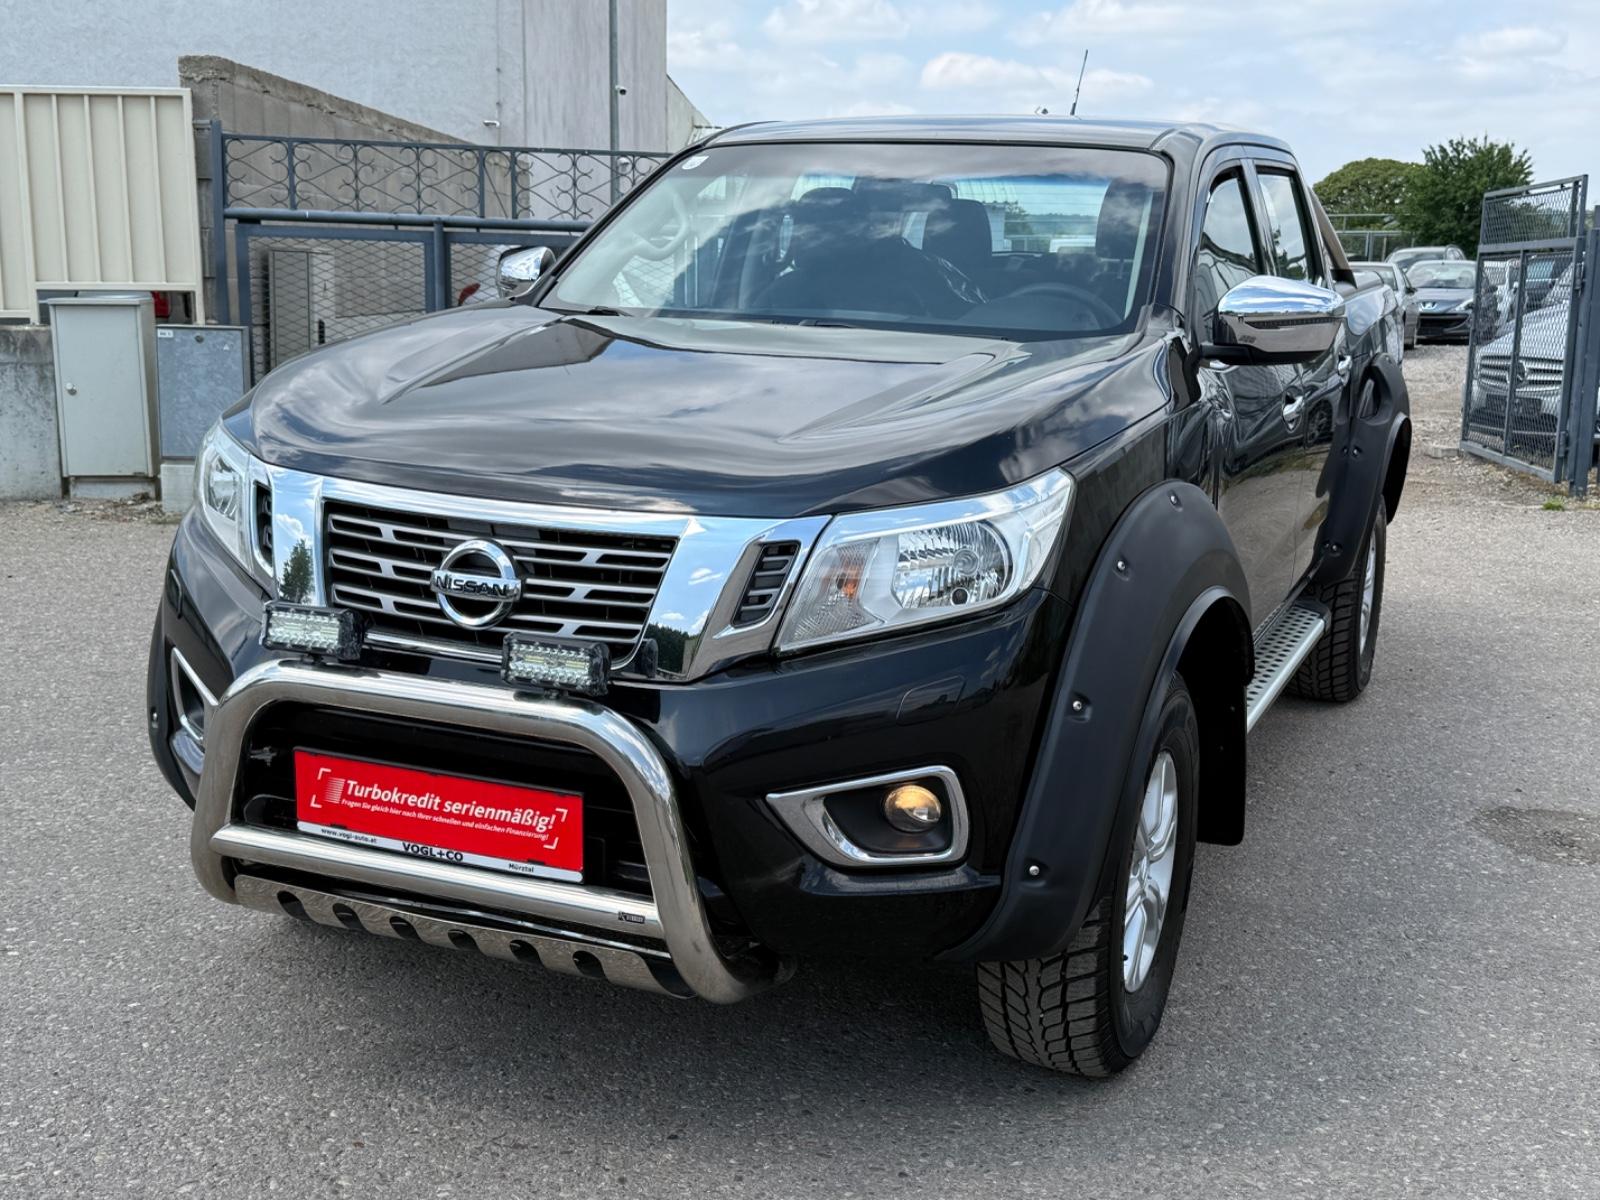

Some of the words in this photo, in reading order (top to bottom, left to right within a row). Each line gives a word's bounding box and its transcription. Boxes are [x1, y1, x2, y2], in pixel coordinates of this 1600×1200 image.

[436, 574, 507, 597] NISSAN
[341, 799, 361, 809] Fragen
[362, 802, 371, 810] Sie
[371, 804, 389, 813] gleich
[389, 807, 401, 815] hier
[402, 809, 417, 818] nach
[417, 812, 432, 821] Ihrer
[432, 814, 461, 826] schnellen
[462, 820, 474, 828] und
[474, 822, 505, 833] einfachen
[506, 827, 550, 841] Finanzierung!
[346, 780, 441, 811] Turbokredit
[442, 800, 556, 833] serienmäßig!
[321, 828, 377, 844] www.vogl-auto.at
[402, 842, 463, 862] VOGL+CO
[508, 862, 534, 874] Mürztal
